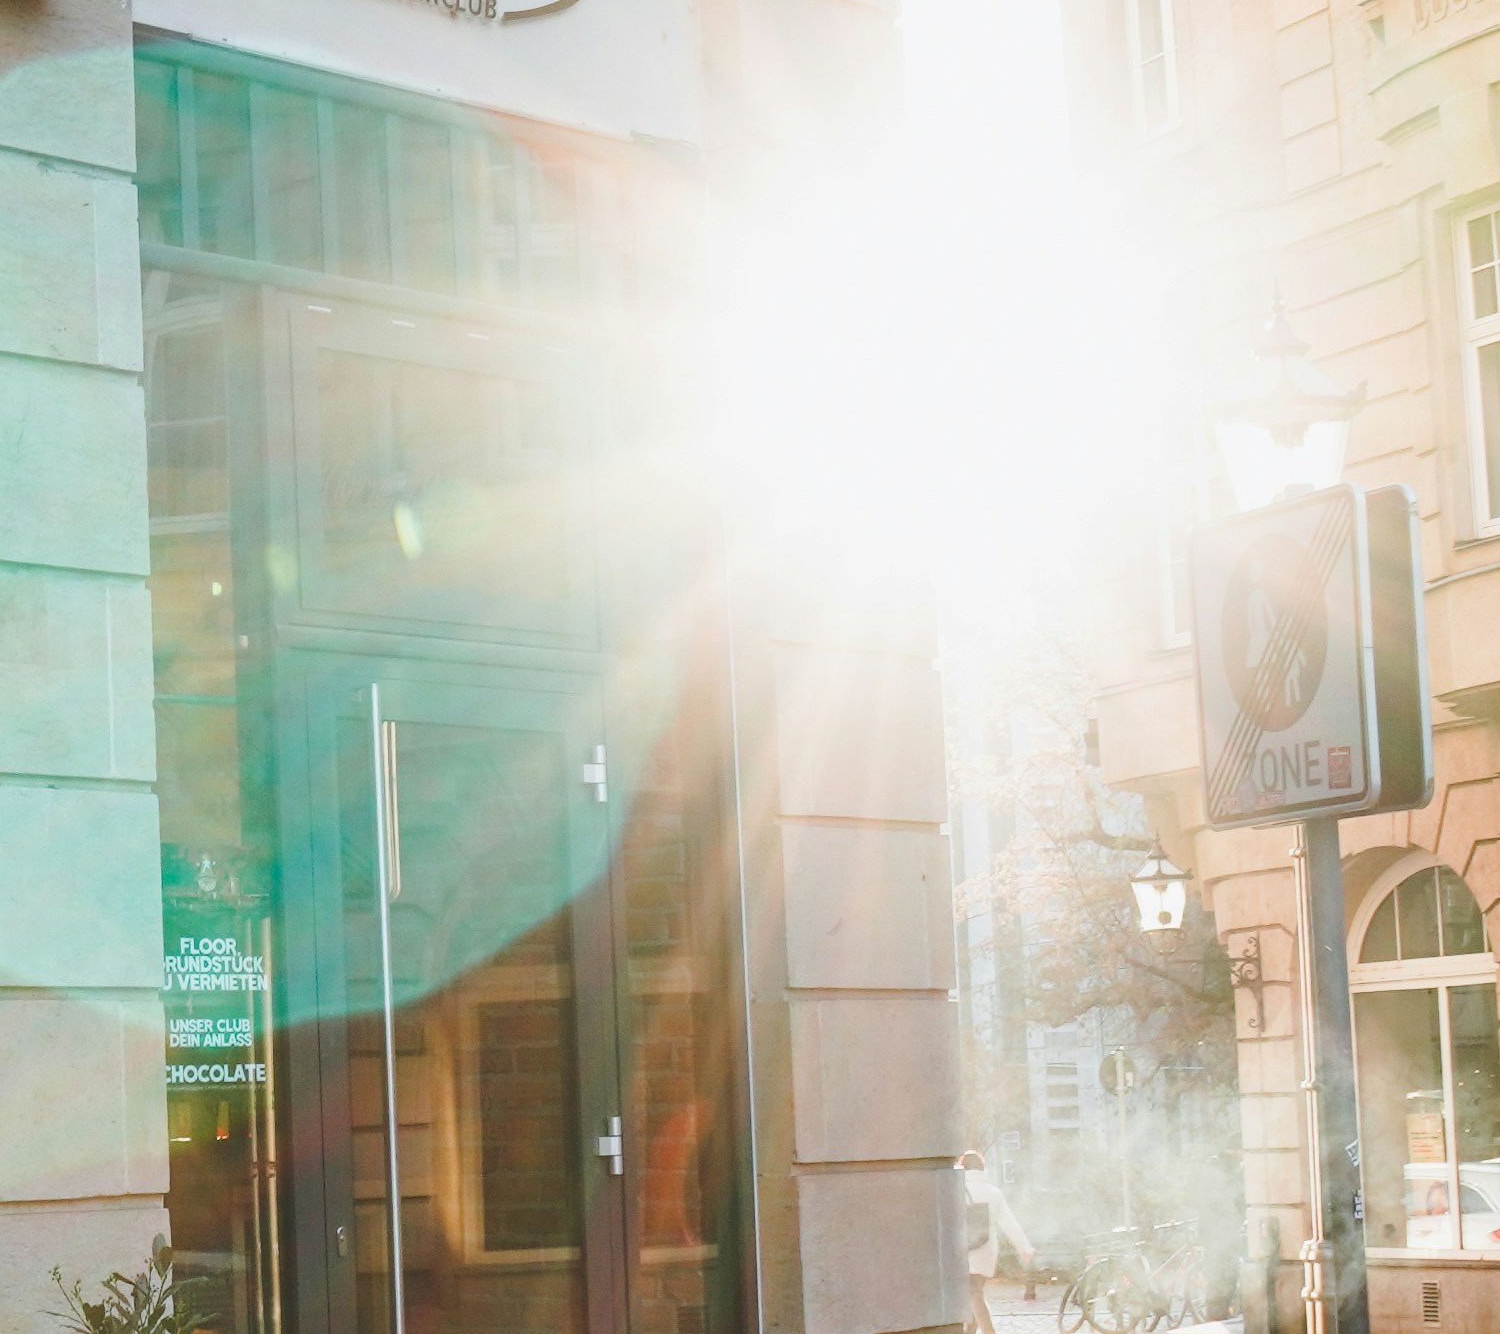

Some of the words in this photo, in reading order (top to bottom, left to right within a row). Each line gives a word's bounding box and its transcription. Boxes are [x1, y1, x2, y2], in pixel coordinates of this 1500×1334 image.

[163, 952, 264, 973] RUNDSTÜCK
[176, 974, 268, 991] VERMIETEN
[169, 1019, 214, 1034] UNSER
[216, 1019, 251, 1034] CLUB
[169, 1033, 201, 1047] DEIN
[202, 1033, 253, 1047] ANLASS
